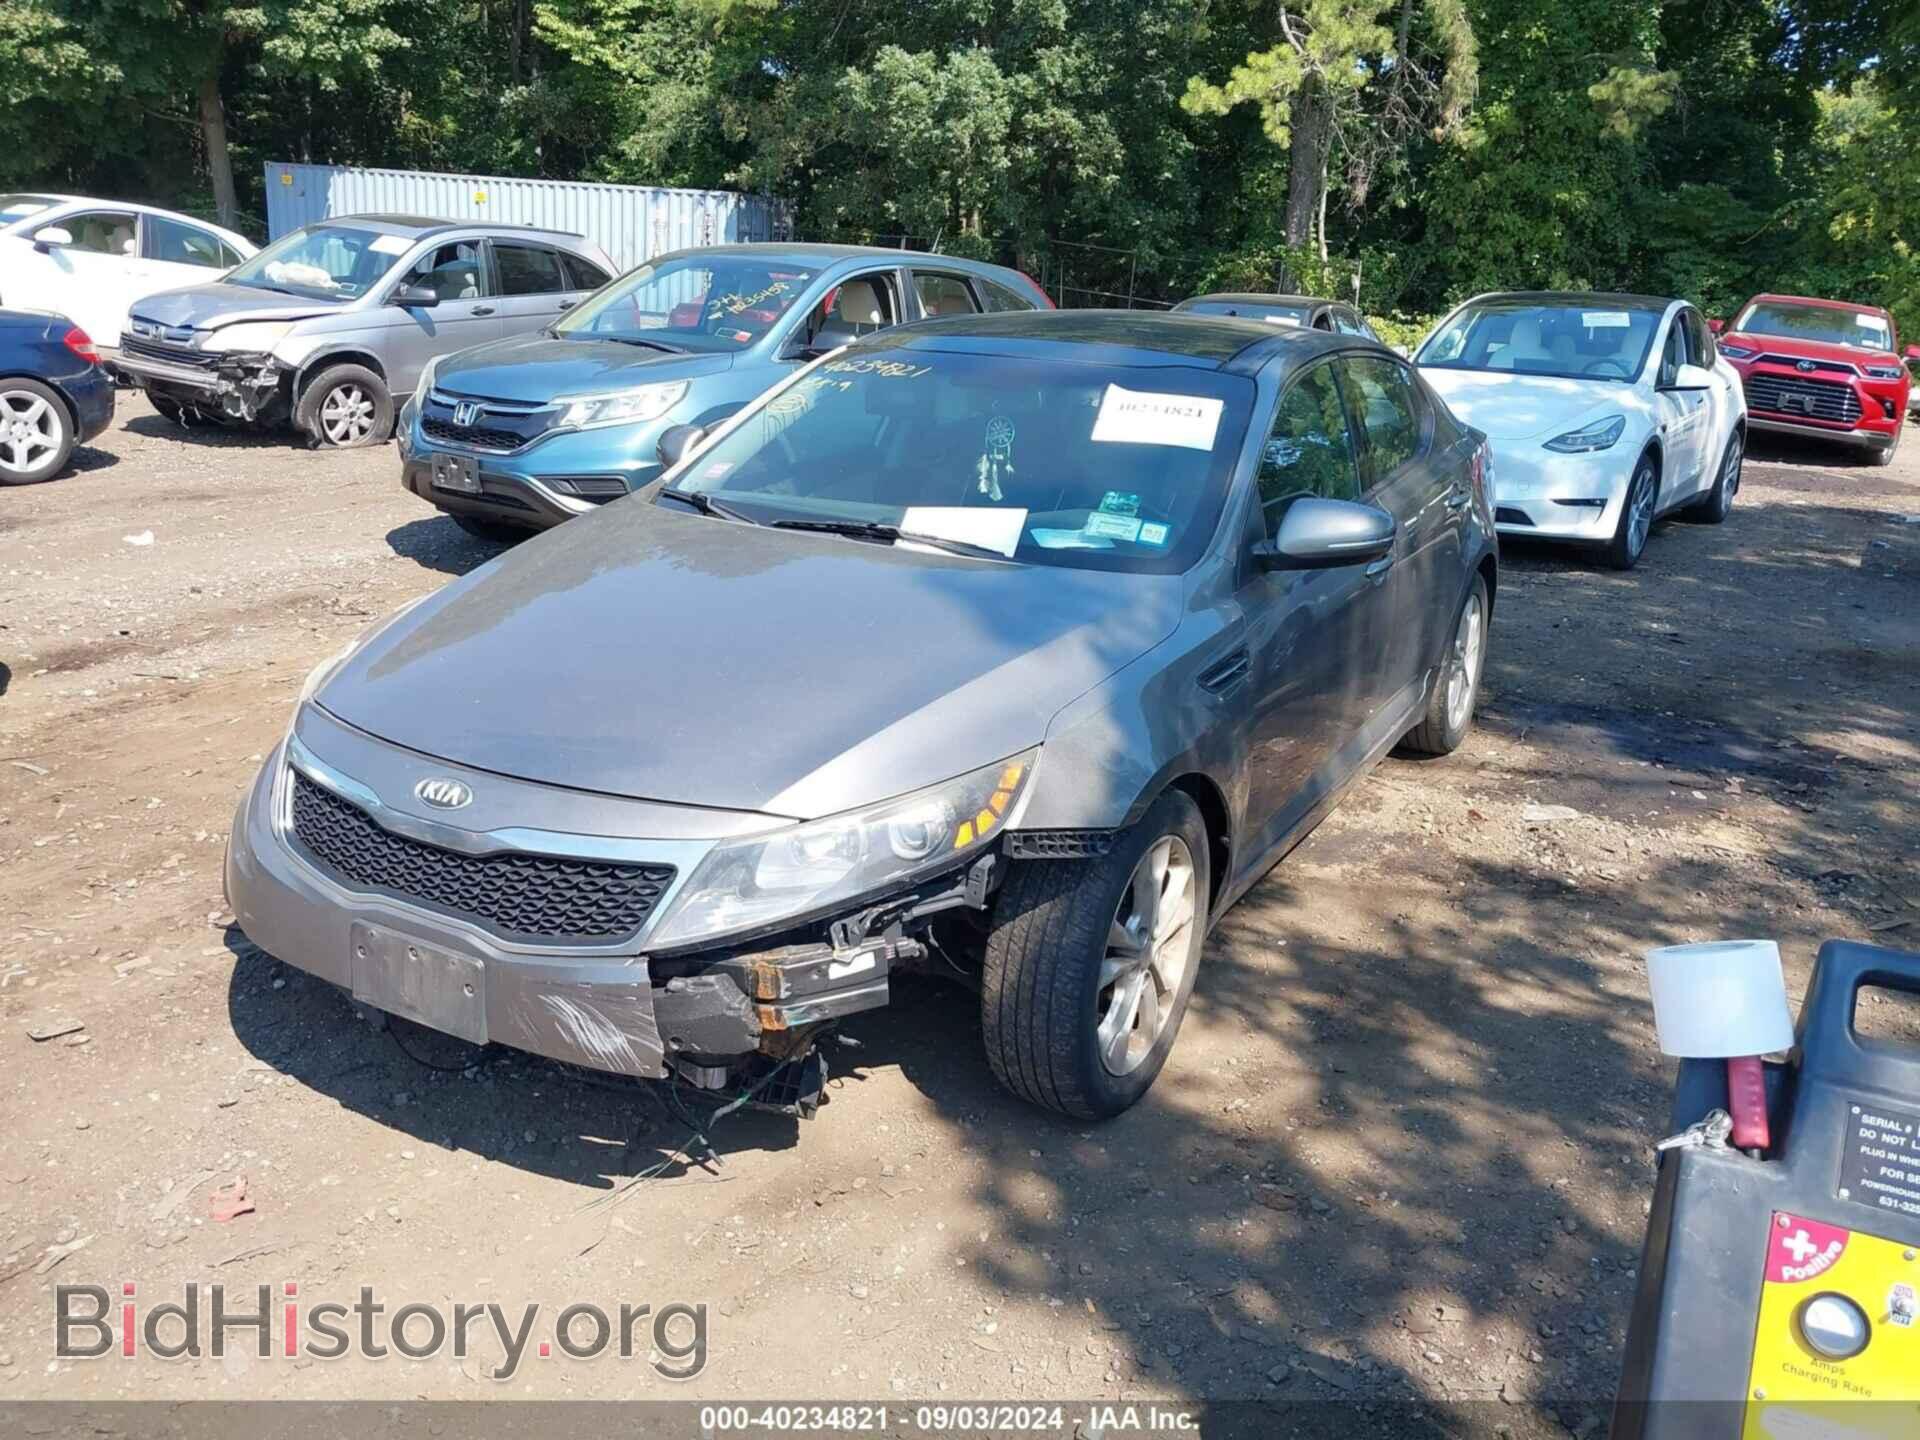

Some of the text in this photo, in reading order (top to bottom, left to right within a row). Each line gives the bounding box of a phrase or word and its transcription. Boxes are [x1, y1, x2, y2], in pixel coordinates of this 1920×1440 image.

[422, 780, 462, 806] KIA
[1861, 1114, 1903, 1132] SERIAL
[1858, 1127, 1877, 1140] DO
[1881, 1132, 1907, 1147] NOT
[1860, 1145, 1886, 1158] PLUG
[1887, 1151, 1898, 1161] IN
[1880, 1166, 1905, 1180] FOR
[1781, 1240, 1843, 1281] Positive
[1810, 1358, 1846, 1376] Amps
[1781, 1361, 1873, 1398] Charging Rate
